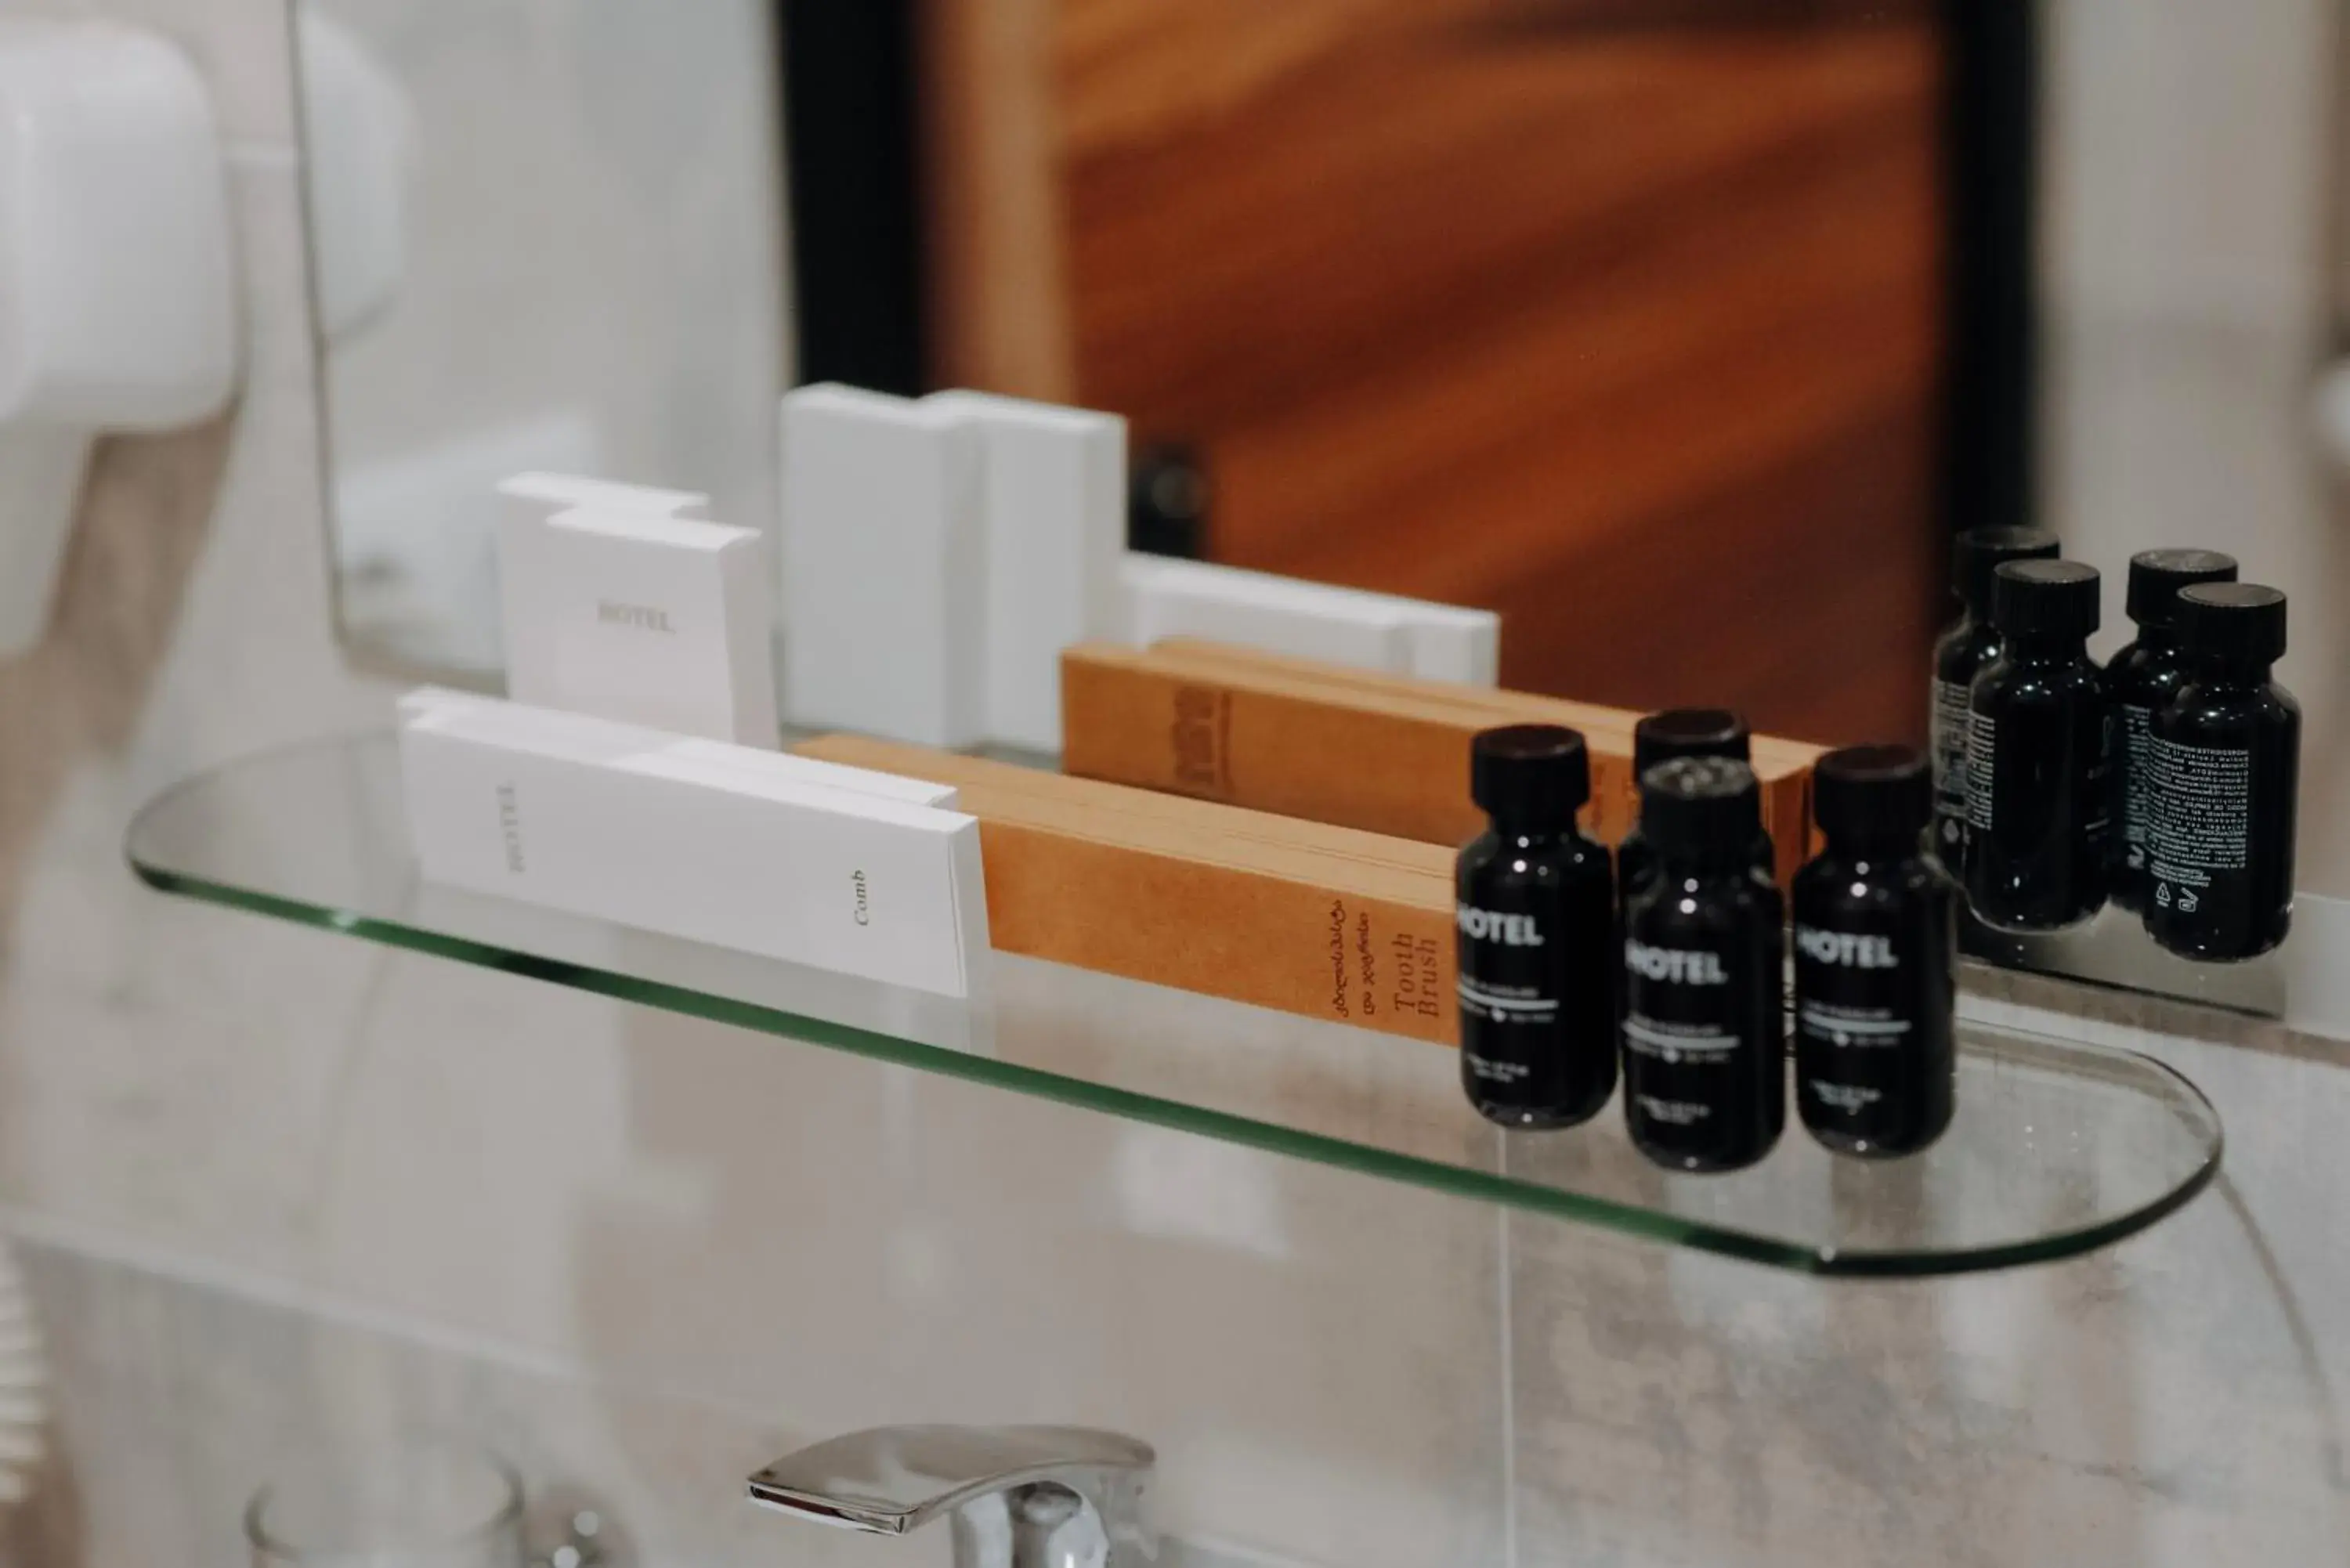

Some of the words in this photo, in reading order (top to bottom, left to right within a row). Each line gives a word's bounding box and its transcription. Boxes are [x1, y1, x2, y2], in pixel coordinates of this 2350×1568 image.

[851, 869, 870, 927] Comb
[1391, 933, 1416, 1011] Tooth
[1415, 938, 1440, 1018] Brush
